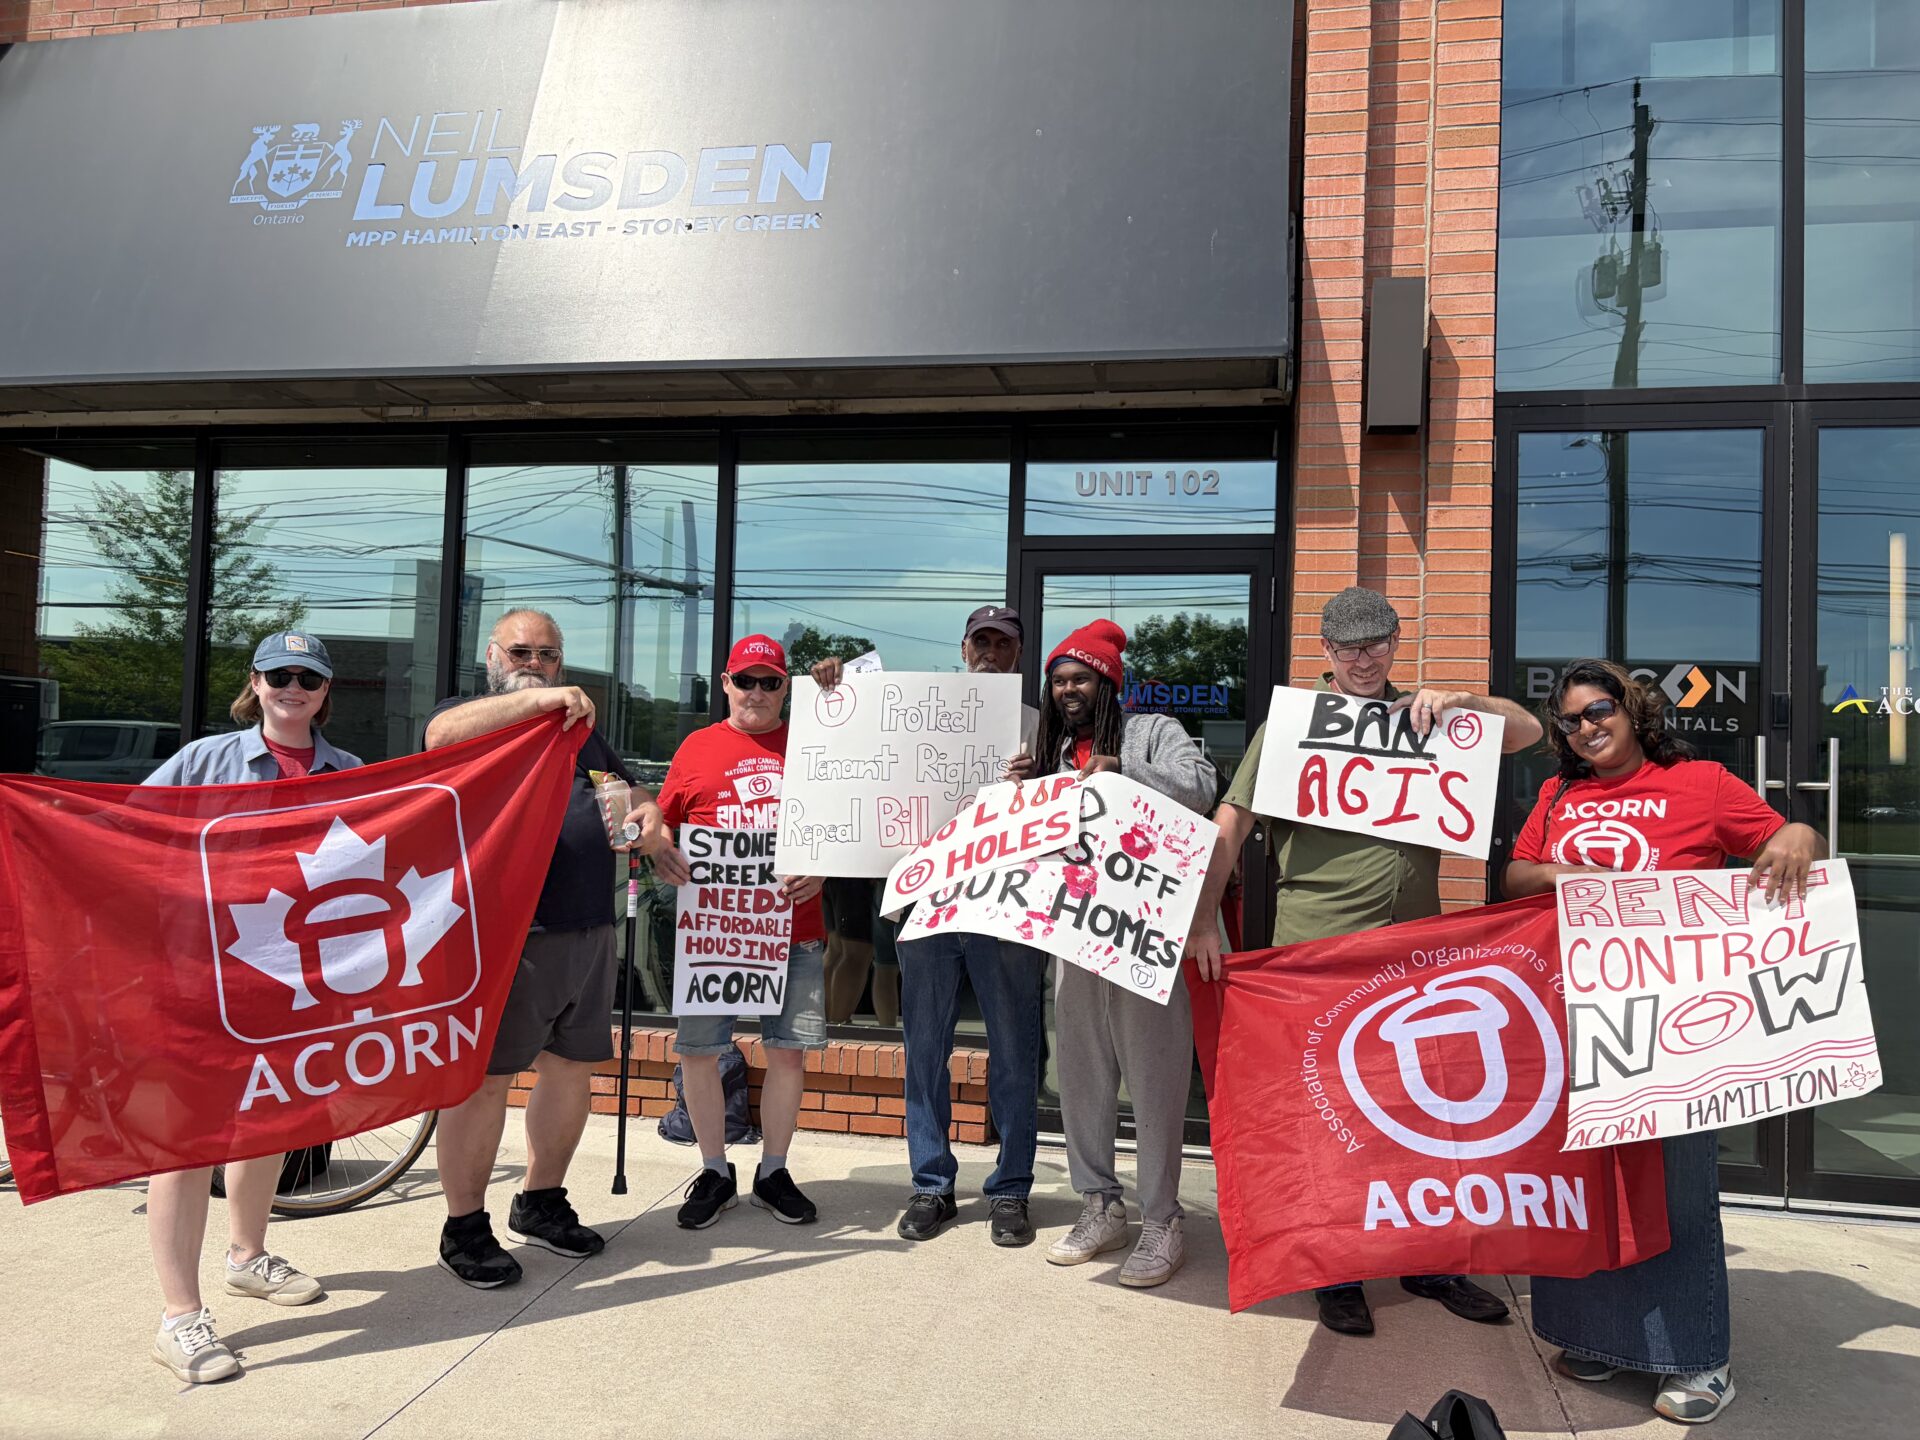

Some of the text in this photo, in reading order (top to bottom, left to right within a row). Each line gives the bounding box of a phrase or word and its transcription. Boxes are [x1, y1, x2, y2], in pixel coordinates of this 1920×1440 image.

[371, 109, 520, 159] NEIL
[352, 141, 832, 221] LUMSDEN
[253, 213, 305, 226] Ontario
[346, 229, 398, 248] MPP
[402, 222, 528, 245] HAMILTON
[535, 220, 602, 240] EAST
[623, 215, 729, 235] STONEY
[734, 212, 824, 233] CREEK
[1076, 470, 1220, 497] UNIT 102
[742, 645, 776, 657] ACORN
[1066, 648, 1110, 673] ACORN
[880, 684, 984, 733] Protect
[1876, 696, 1920, 715] AC
[1880, 686, 1912, 696] THE
[1304, 693, 1437, 754] BAN
[1664, 716, 1740, 732] NTALS
[724, 764, 784, 777] NATIONAL CONVENT
[737, 757, 780, 768] ACORN CANADA
[801, 743, 1012, 802] Tenant Rights
[1297, 755, 1476, 842] AGI'S
[1558, 799, 1667, 820] ACORN
[688, 828, 777, 859] STONE
[783, 798, 861, 861] Repeal
[877, 796, 929, 848] Bill
[946, 810, 1072, 880] HOLES
[690, 861, 778, 887] CREEK
[1105, 850, 1182, 900] OFF
[698, 887, 792, 915] NEEDS
[1561, 868, 1829, 928] RENT
[677, 909, 792, 938] AFFORDABLE
[1050, 882, 1182, 969] HOMES
[685, 935, 789, 962] HOUSING
[1411, 942, 1548, 973] Organizations
[1568, 921, 1840, 993] CONTROL
[685, 970, 784, 1005] ACORN
[1314, 961, 1406, 1028] Community
[1306, 1029, 1324, 1045] of
[239, 1006, 484, 1112] ACORN
[1300, 1048, 1365, 1155] Association
[1566, 1064, 1839, 1150] ACORN HAMILTON
[1364, 1172, 1589, 1232] ACORN
